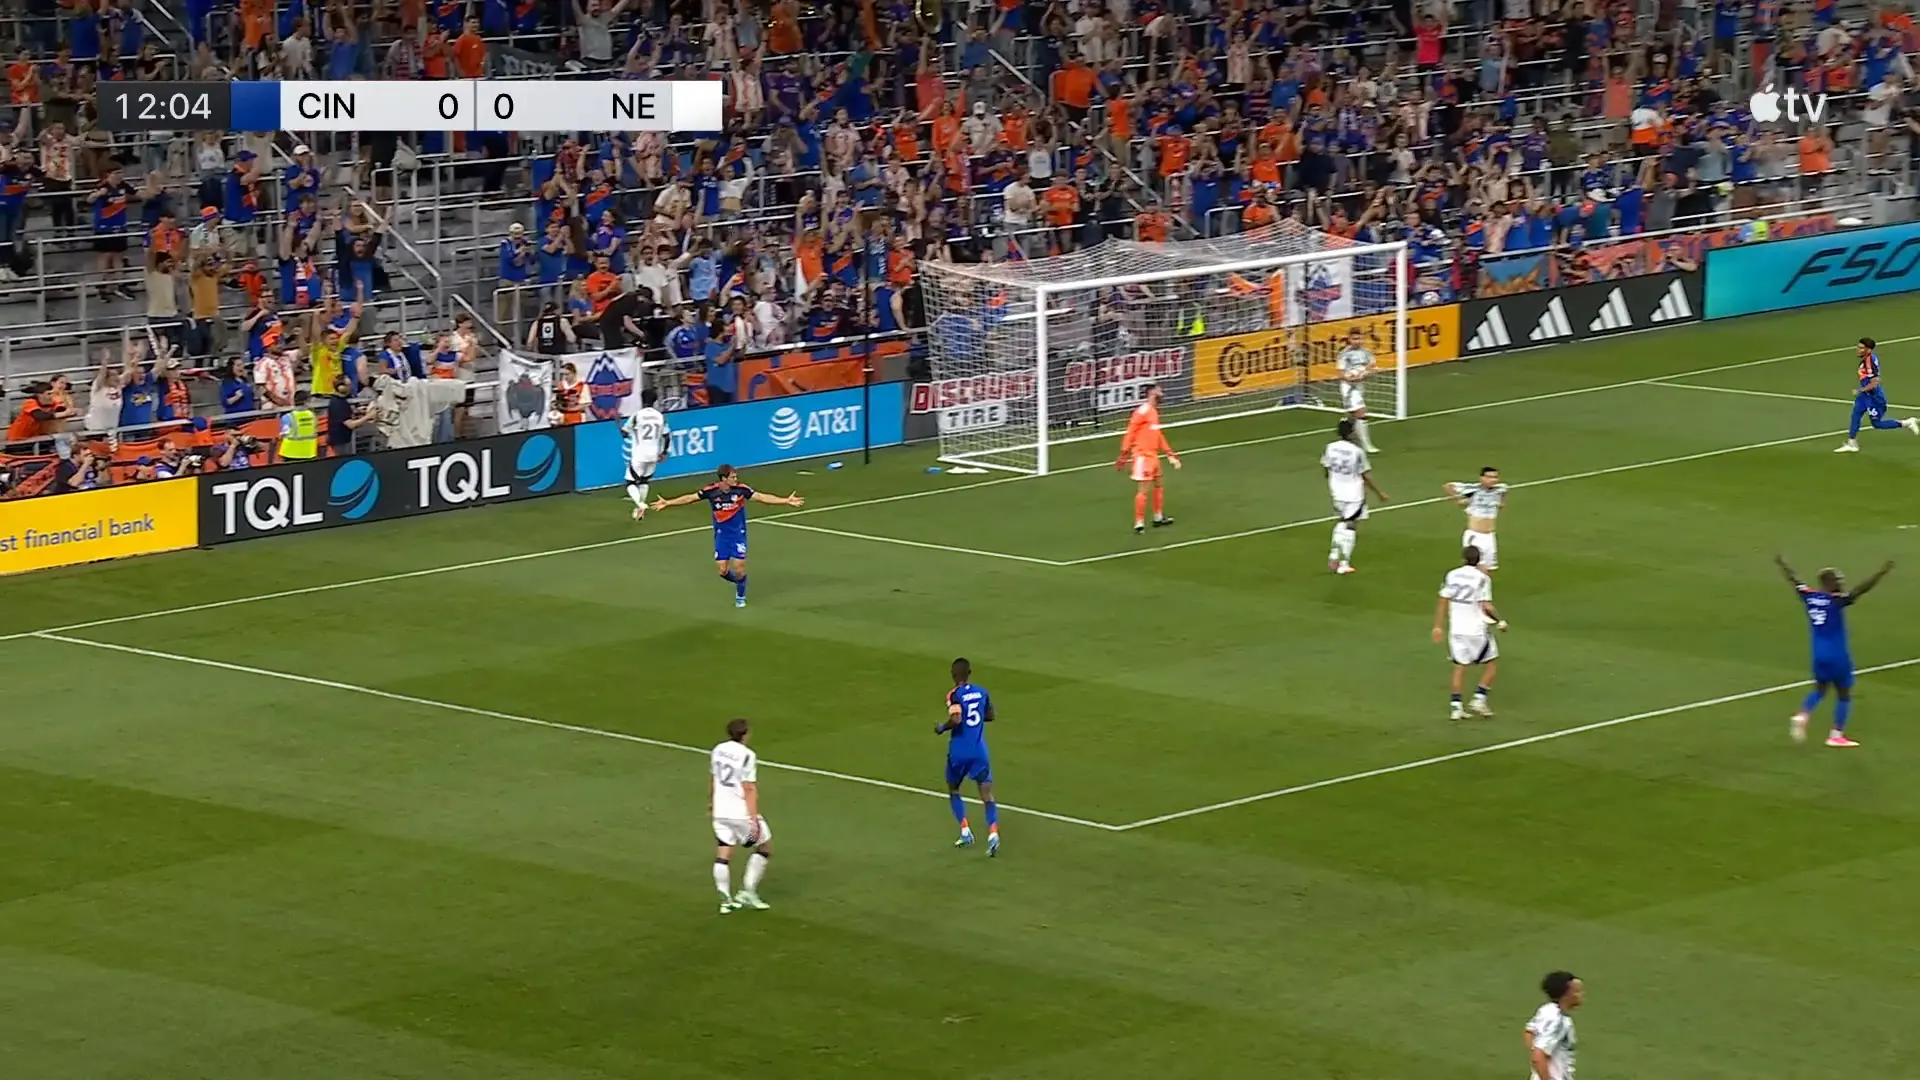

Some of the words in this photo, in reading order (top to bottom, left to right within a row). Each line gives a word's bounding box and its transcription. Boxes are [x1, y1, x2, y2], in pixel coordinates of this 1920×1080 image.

[1064, 348, 1186, 391] DISCOUNT
[1218, 330, 1354, 388] Continenta
[1385, 317, 1441, 352] Tire
[910, 369, 1037, 414] DISCOUNT
[642, 423, 660, 440] 21
[804, 405, 862, 438] AT&T
[948, 405, 999, 427] TIRE
[407, 449, 511, 508] TQL
[211, 474, 324, 535] TQL
[24, 519, 103, 549] financial
[109, 513, 155, 537] bank
[966, 701, 981, 727] 5
